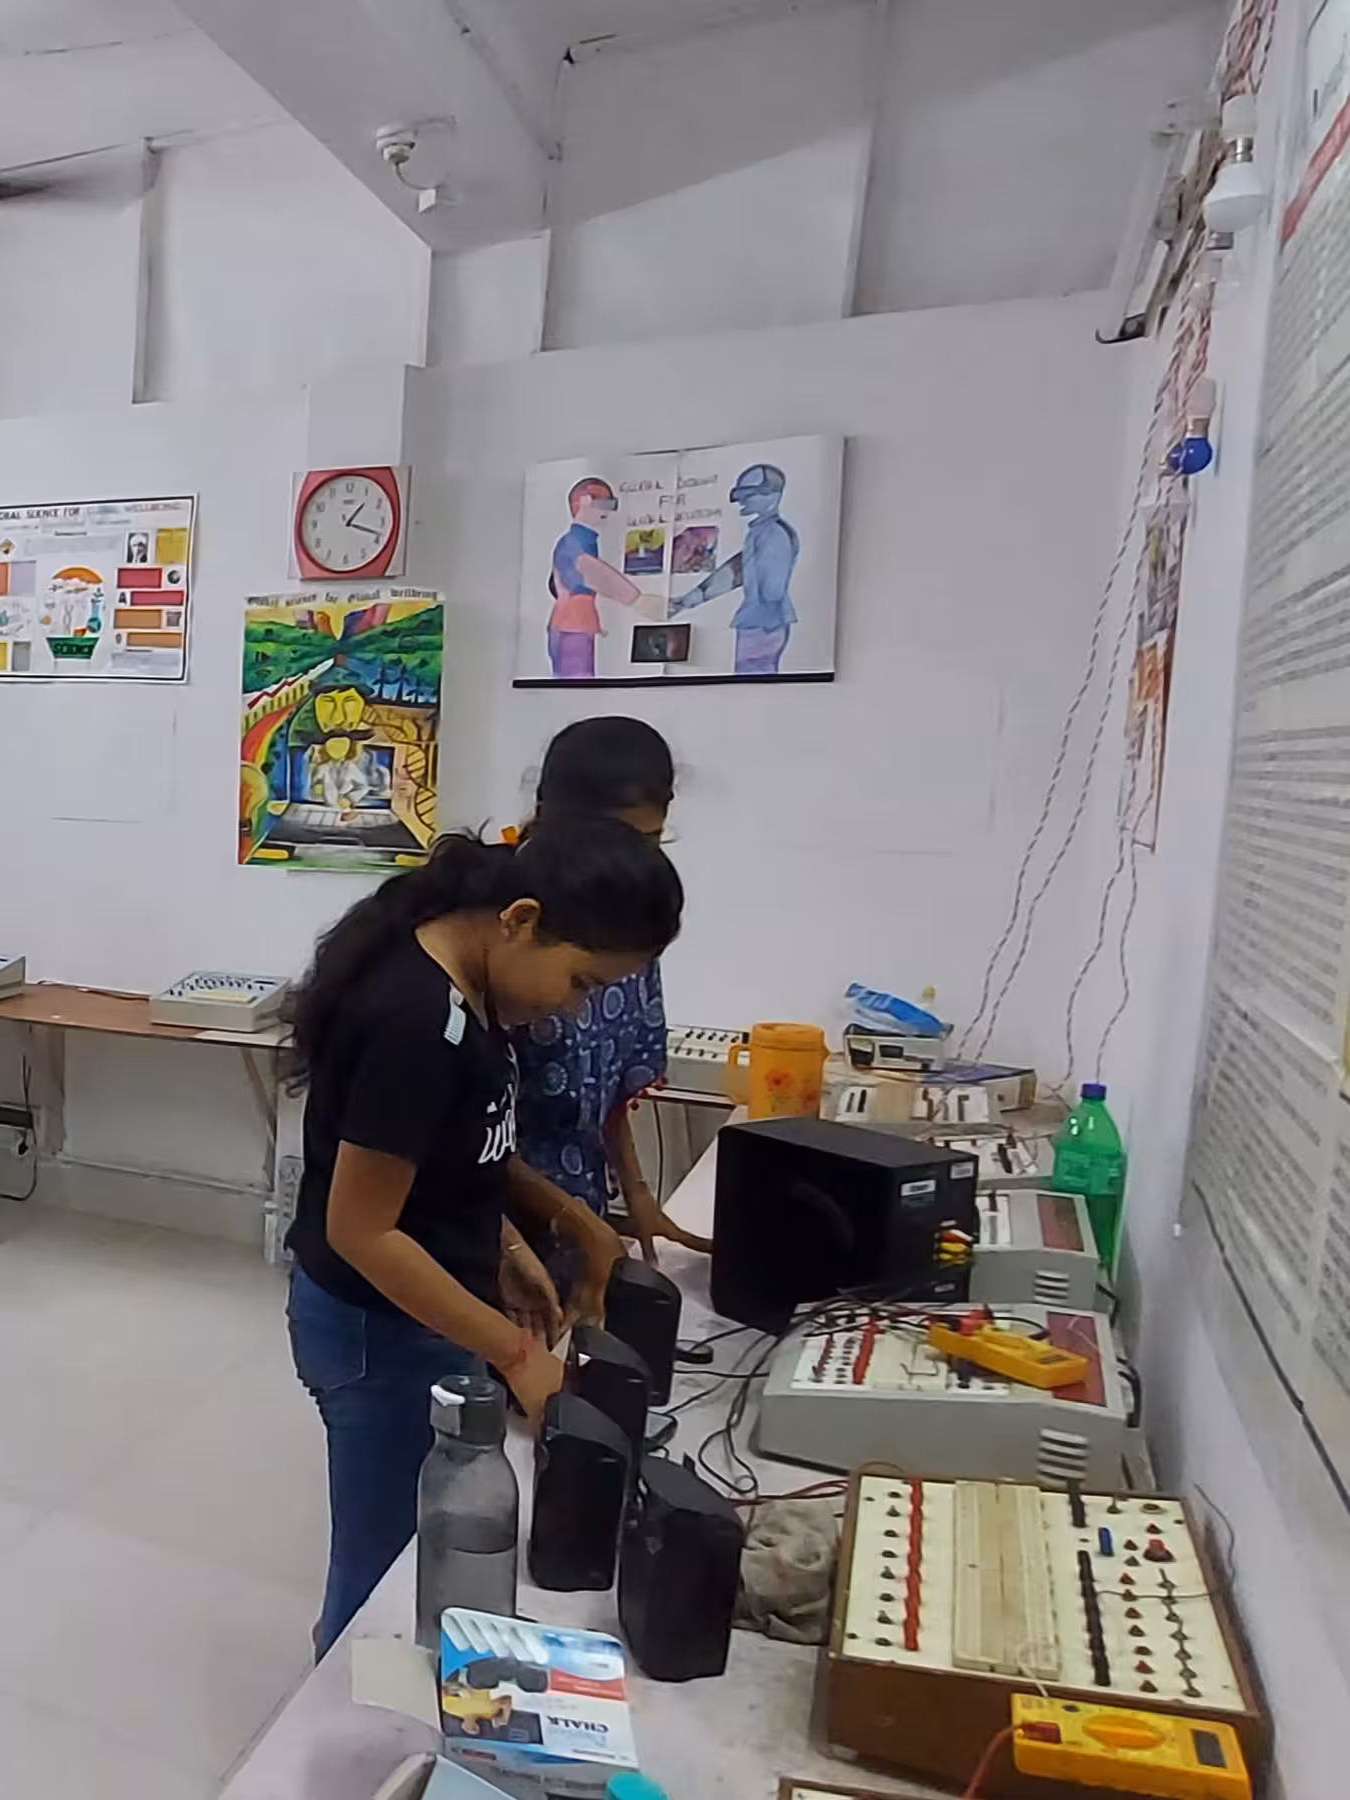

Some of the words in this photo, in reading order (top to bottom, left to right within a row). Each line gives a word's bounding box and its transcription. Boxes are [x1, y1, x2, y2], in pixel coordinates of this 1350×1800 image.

[345, 482, 354, 493] 12
[63, 507, 81, 517] FOR
[546, 1714, 609, 1734] CHALK
